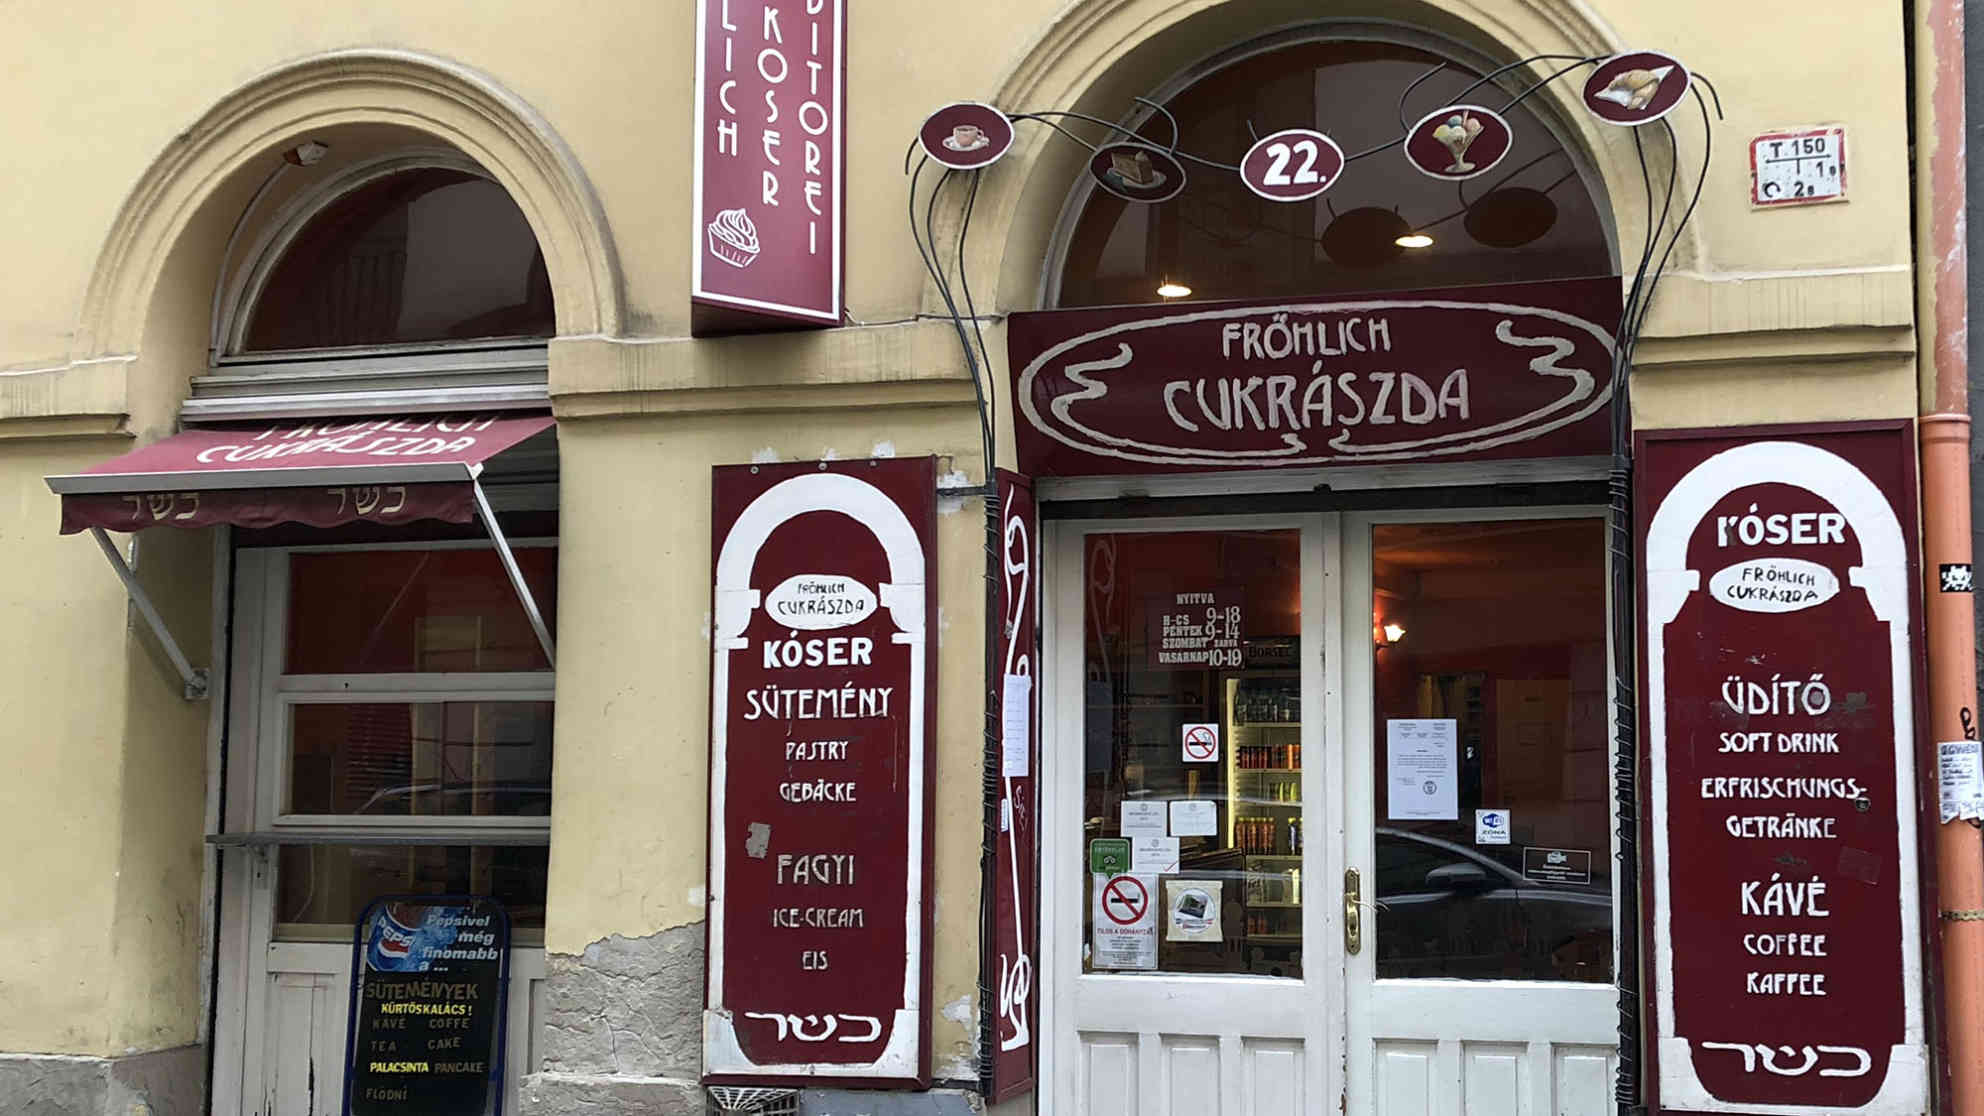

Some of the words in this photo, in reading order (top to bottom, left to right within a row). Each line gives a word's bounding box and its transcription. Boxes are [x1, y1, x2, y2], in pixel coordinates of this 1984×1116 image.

[757, 5, 788, 206] KOSER
[1769, 141, 1783, 158] T
[1791, 138, 1826, 156] 150
[1263, 140, 1328, 186] 22.
[1163, 360, 1470, 432] CUKRÁSZDA
[121, 492, 201, 521] כשר
[327, 485, 407, 516] כשר
[1718, 503, 1845, 547] KÓSER
[1742, 565, 1816, 587] FRÖHLICH
[1176, 592, 1215, 605] NYITVA
[1727, 585, 1819, 603] CUKRÁSZDA
[777, 595, 865, 616] CUKRÁSZDA
[1163, 614, 1190, 626] H-CS
[1206, 606, 1241, 625] 9-18
[1162, 637, 1209, 649] SZOMBAT
[1205, 624, 1241, 641] 9-14
[763, 630, 873, 669] KÓSER
[1208, 648, 1242, 667] 10-19
[743, 681, 893, 720] SÜTEMÉNY
[1722, 673, 1831, 716] ÜDÍTŐ
[785, 741, 849, 760] PASTRY
[1718, 732, 1772, 753] SOFT
[1777, 732, 1840, 753] DRINK
[779, 779, 857, 802] GEBÄCKE
[1701, 777, 1867, 799] ERFRISCHUNGS-
[1725, 812, 1837, 838] GETRÄNKE
[777, 854, 855, 885] FAGYI
[1741, 872, 1830, 917] KÁVÉ
[426, 914, 491, 928] Pepsivel
[773, 907, 864, 928] ICE-CREAM
[457, 930, 496, 946] még
[1743, 933, 1827, 956] COFFEE
[421, 946, 498, 960] finomabb
[802, 951, 829, 970] EIS
[418, 961, 430, 972] a
[365, 976, 479, 1000] SÜTEMÉNYEK
[1746, 971, 1827, 995] KAFFEE
[428, 1017, 472, 1029] COFFE
[744, 1012, 882, 1043] כשר
[370, 1040, 397, 1052] TEA
[427, 1037, 462, 1050] CAKE
[369, 1061, 430, 1073] PALACSINTA
[434, 1061, 486, 1073] PANCAKE
[1701, 1041, 1872, 1077] כשר
